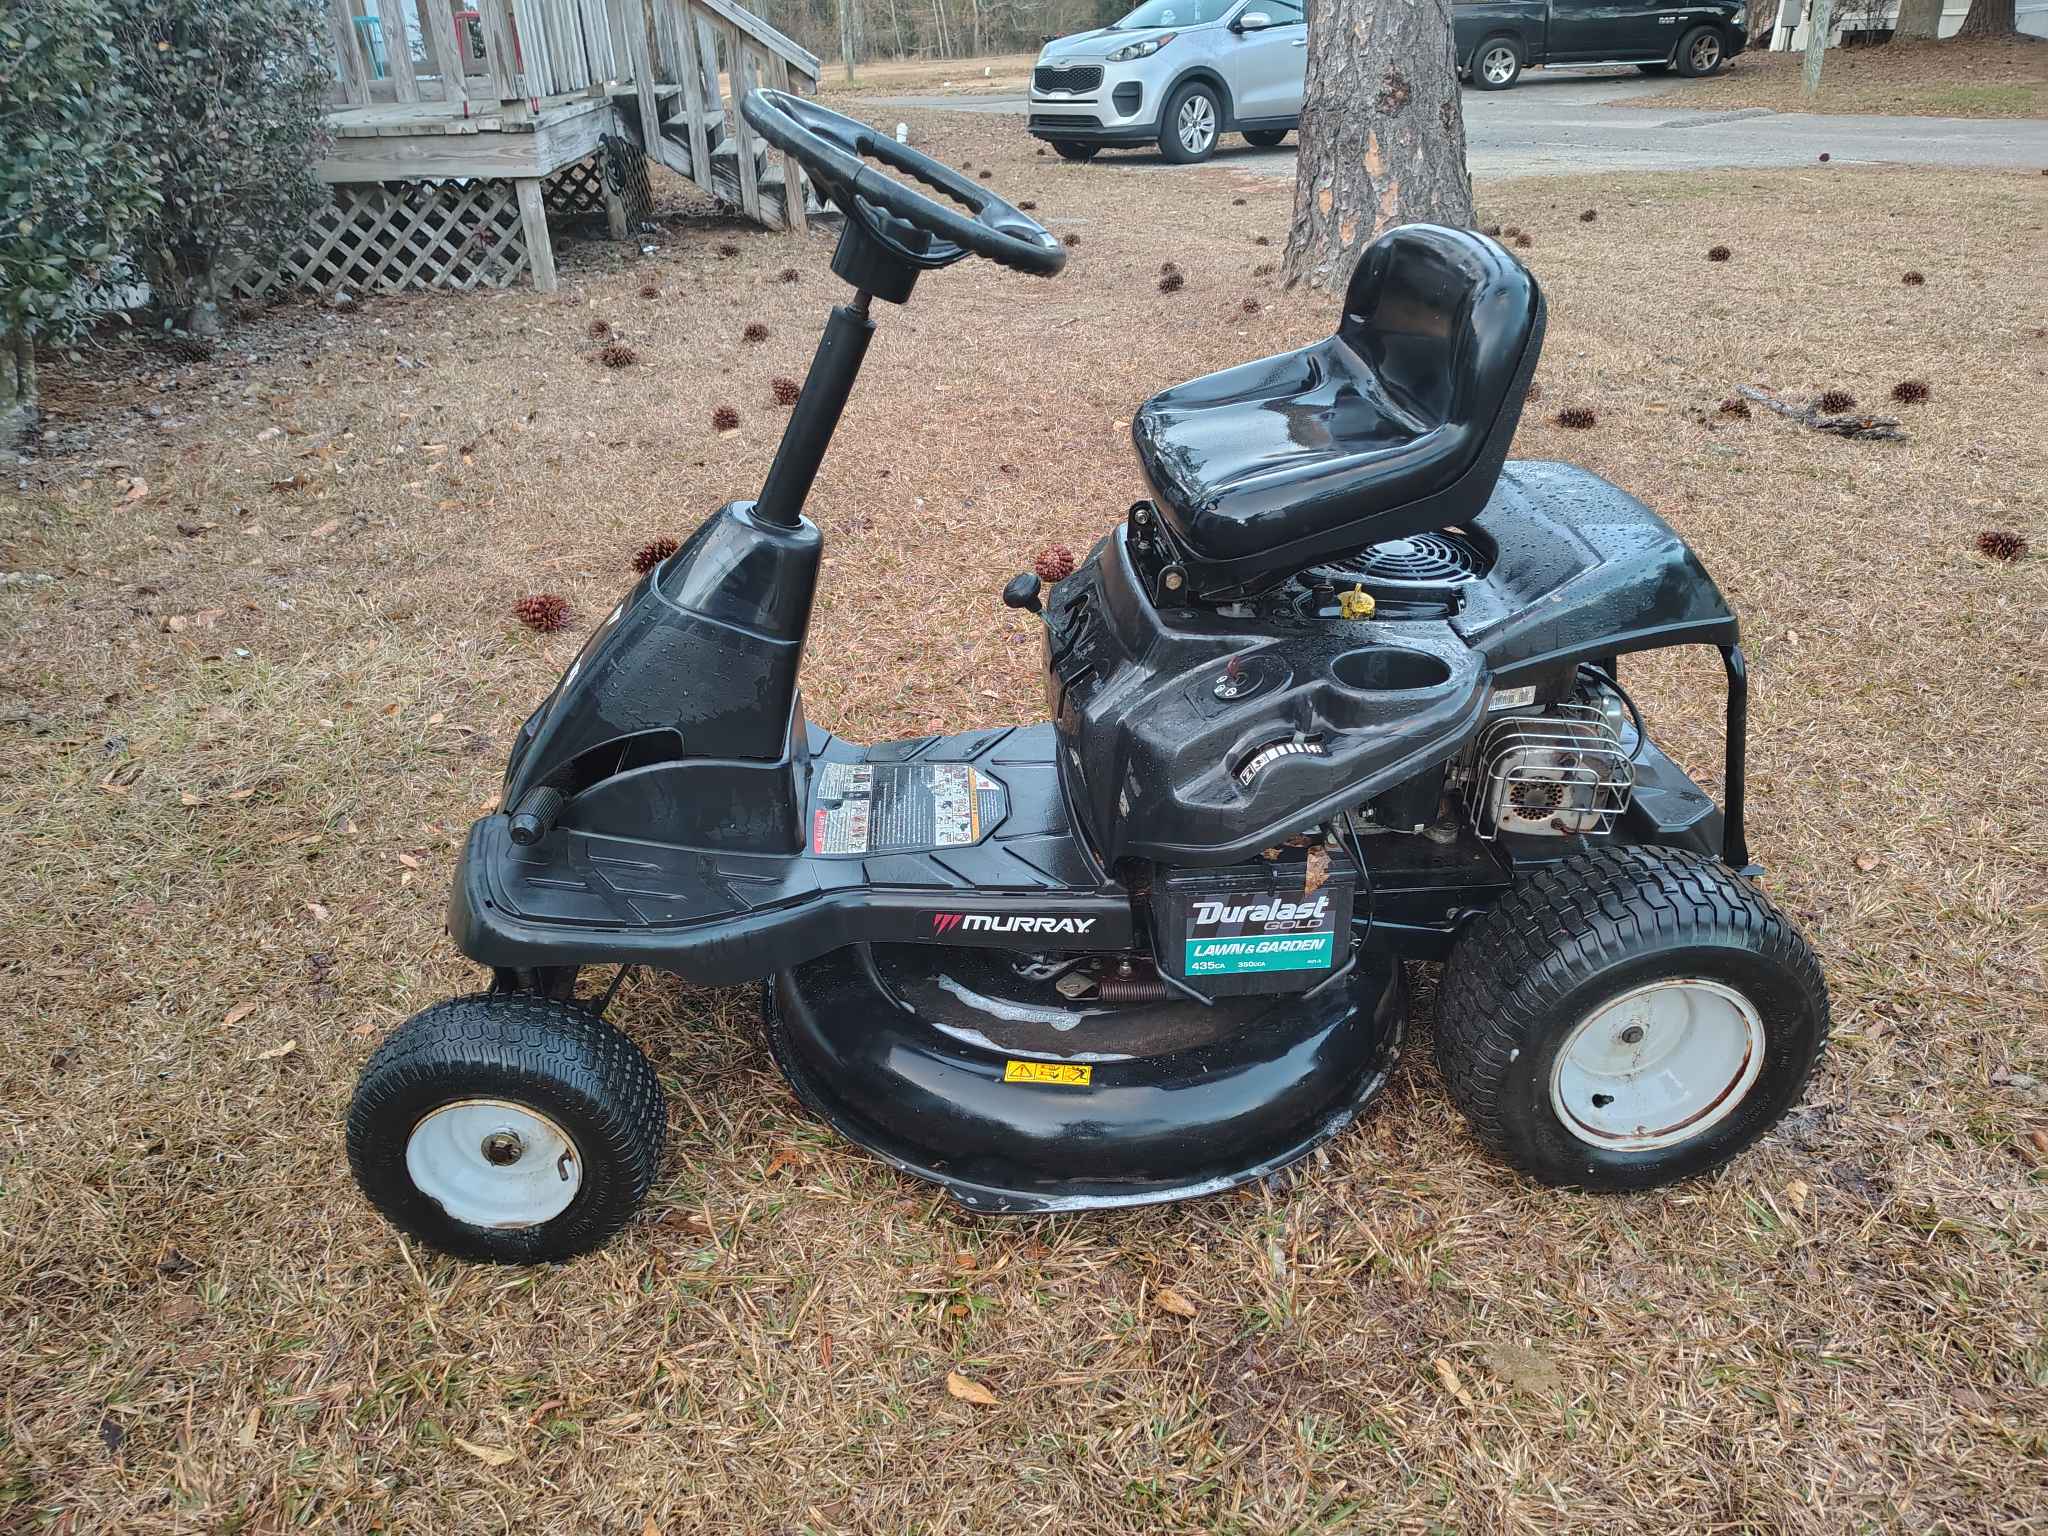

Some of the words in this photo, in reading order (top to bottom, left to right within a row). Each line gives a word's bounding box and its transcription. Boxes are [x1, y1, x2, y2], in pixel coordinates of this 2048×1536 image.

[1192, 896, 1329, 925] Duralast
[962, 914, 1097, 933] MURRAY
[1263, 919, 1324, 931] GOLD
[1193, 943, 1247, 957] LAWN
[1256, 938, 1326, 954] GARDEN
